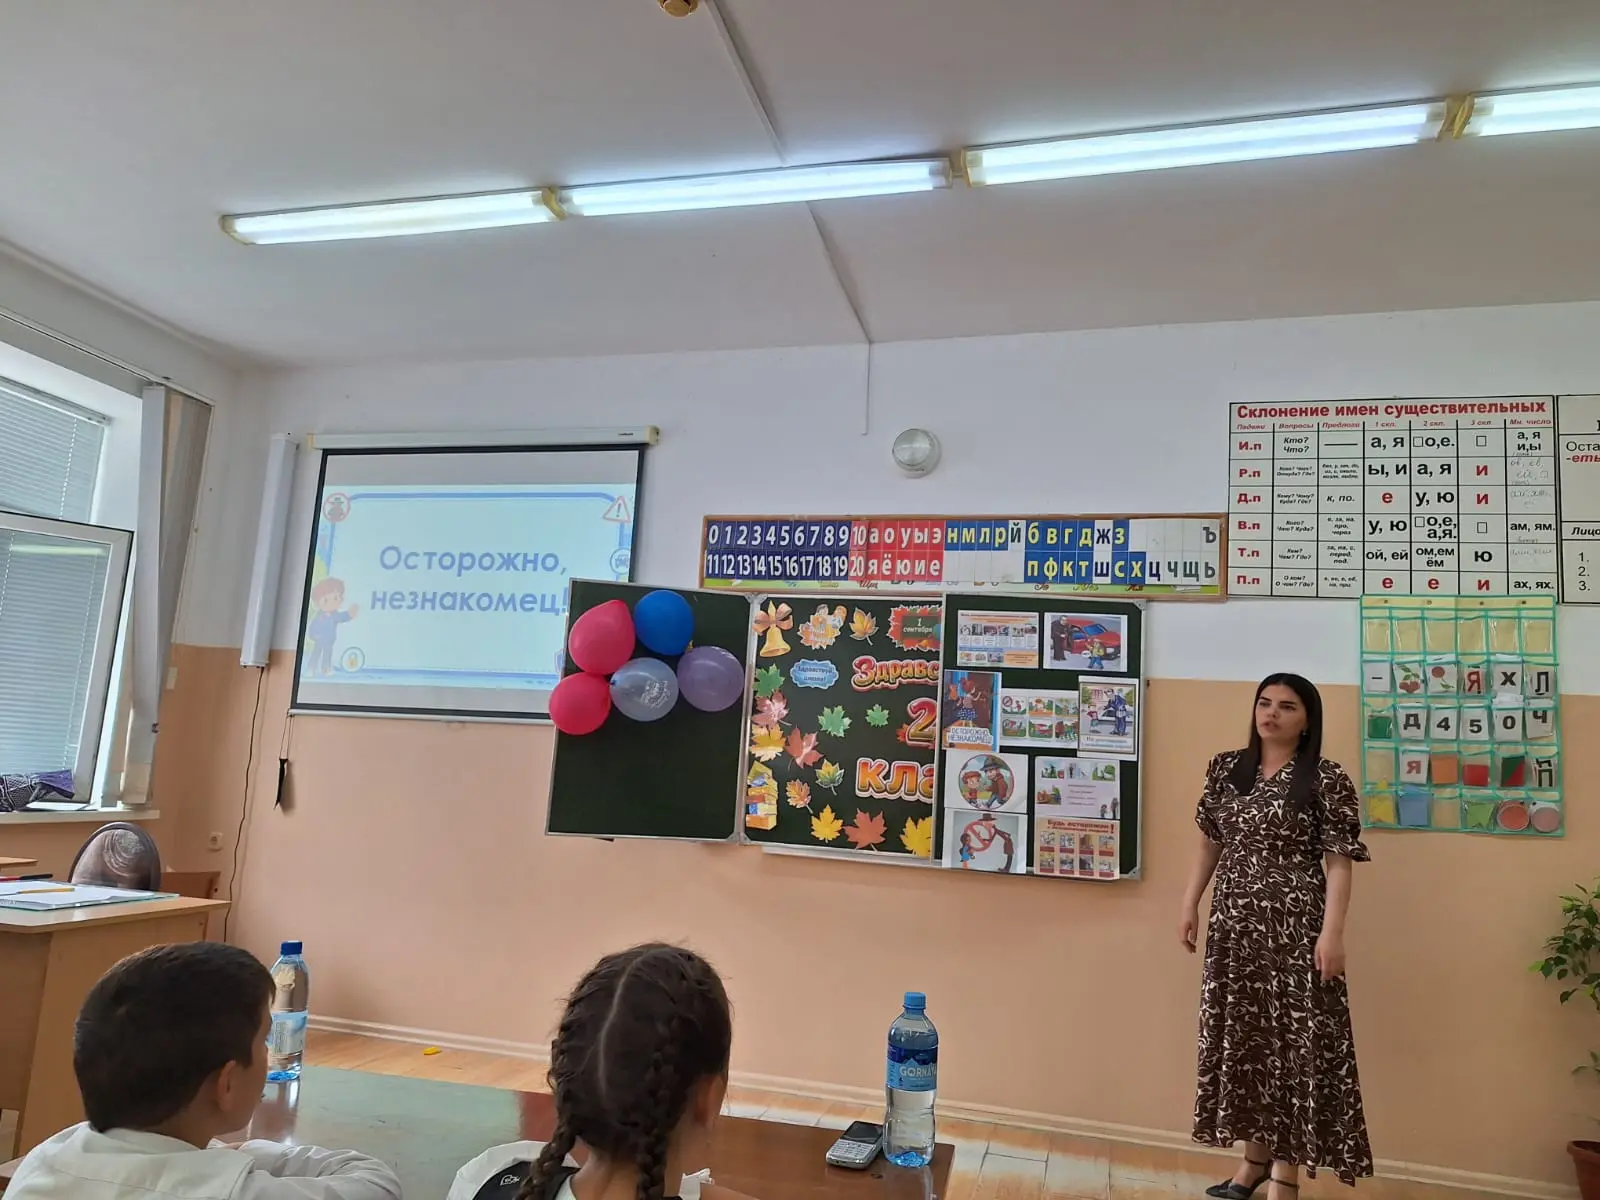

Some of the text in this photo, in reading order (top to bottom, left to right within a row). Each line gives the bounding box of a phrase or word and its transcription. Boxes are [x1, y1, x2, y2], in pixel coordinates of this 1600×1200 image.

[1238, 402, 1546, 418] Склонение имен существительных
[1532, 432, 1541, 440] я
[1238, 441, 1262, 450] И.п
[1370, 436, 1404, 450] а, я
[1517, 443, 1541, 452] и,ы
[1566, 441, 1600, 452] Оста
[1239, 468, 1261, 478] Р.п
[1368, 464, 1389, 478] ы,
[1396, 464, 1407, 475] и
[1416, 464, 1452, 478] а, я
[1476, 464, 1488, 476] и
[1237, 493, 1261, 504] Д.п
[1382, 493, 1393, 503] е
[1415, 492, 1454, 507] у, ю
[1476, 493, 1488, 504] и
[1238, 521, 1260, 530] В.п
[1368, 520, 1407, 535] у, ю
[1510, 523, 1530, 532] ам,
[725, 526, 732, 544] 1
[737, 526, 748, 545] 2
[752, 526, 762, 546] 3
[766, 526, 776, 546] 4
[780, 526, 790, 546] 5
[794, 526, 805, 546] 6
[809, 526, 820, 546] 7
[824, 526, 835, 546] 8
[838, 526, 849, 546] 9
[852, 526, 867, 546] 10
[869, 529, 879, 544] а
[914, 528, 928, 544] ы
[994, 528, 1006, 547] р
[1010, 522, 1021, 544] й
[1028, 522, 1040, 544] б
[1237, 548, 1260, 557] Т.п
[1366, 549, 1408, 561] ой, ей
[1416, 548, 1454, 557] ом,ем
[1474, 551, 1493, 562] ю
[1578, 552, 1589, 562] 1.
[379, 545, 568, 577] Осторожно,
[707, 554, 719, 574] 11
[722, 554, 735, 575] 12
[738, 554, 750, 576] 13
[752, 555, 766, 576] 14
[768, 556, 782, 576] 15
[784, 556, 798, 576] 16
[800, 556, 815, 576] 17
[816, 556, 831, 576] 18
[833, 556, 848, 577] 19
[850, 556, 864, 577] 20
[867, 559, 878, 575] я
[882, 554, 892, 575] ё
[896, 559, 911, 575] ю
[915, 560, 926, 575] и
[930, 560, 941, 576] е
[1426, 557, 1444, 567] ём
[1578, 567, 1590, 577] 2.
[1237, 576, 1260, 584] П.п
[1382, 578, 1394, 588] е
[1428, 578, 1439, 589] е
[1478, 579, 1490, 591] и
[1514, 581, 1532, 590] ах,
[1578, 581, 1590, 591] 3.
[370, 586, 570, 616] незнакомец!
[917, 618, 922, 626] 1
[903, 626, 932, 635] сентября
[852, 655, 940, 689] Здравс
[1467, 670, 1481, 692] Я
[908, 698, 938, 743] 2
[1436, 716, 1450, 731] 4
[1469, 719, 1482, 734] 5
